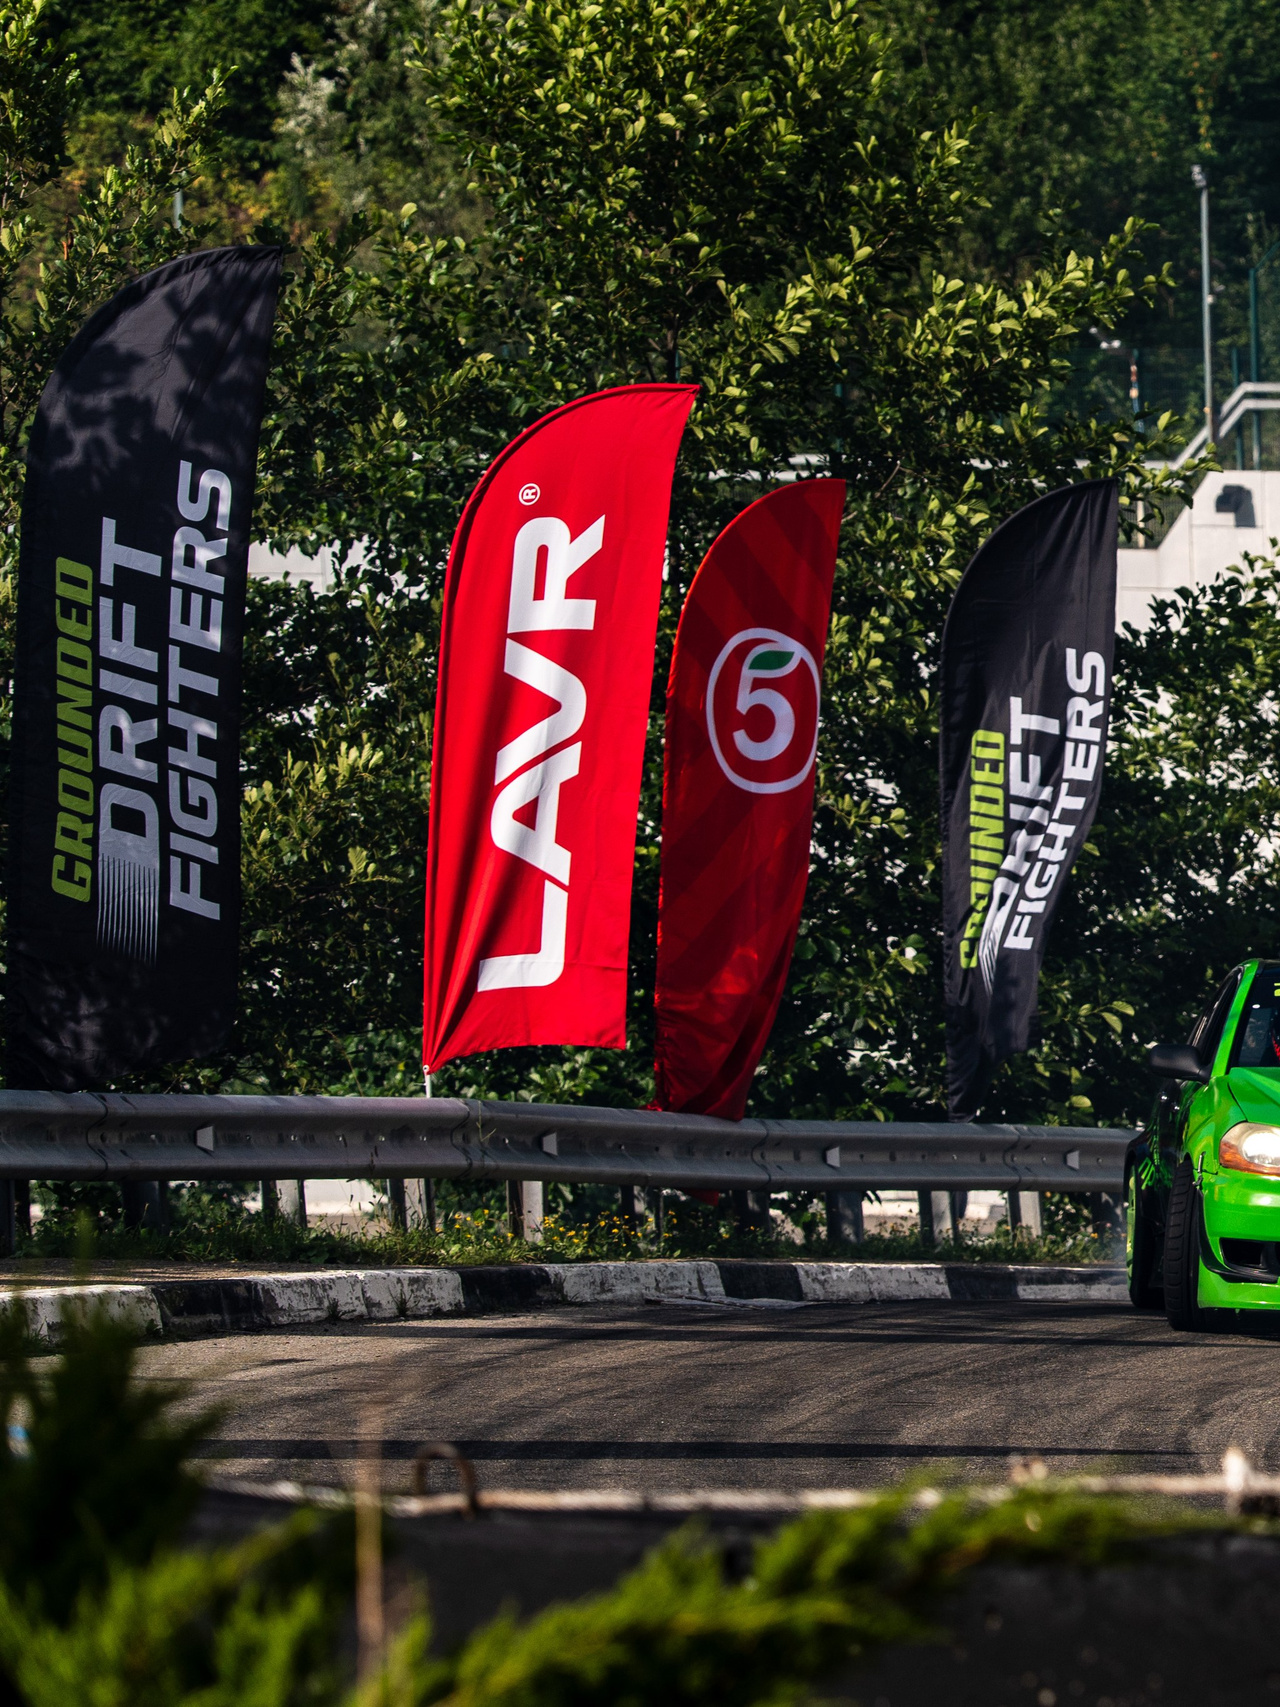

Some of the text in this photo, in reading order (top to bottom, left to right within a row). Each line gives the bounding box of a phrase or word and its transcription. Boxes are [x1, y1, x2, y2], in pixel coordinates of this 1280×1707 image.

[51, 556, 94, 903] GROUNDED
[98, 516, 162, 966] DRIFT
[168, 459, 232, 921] FIGHTERS
[1003, 647, 1105, 951] FIGHTERS
